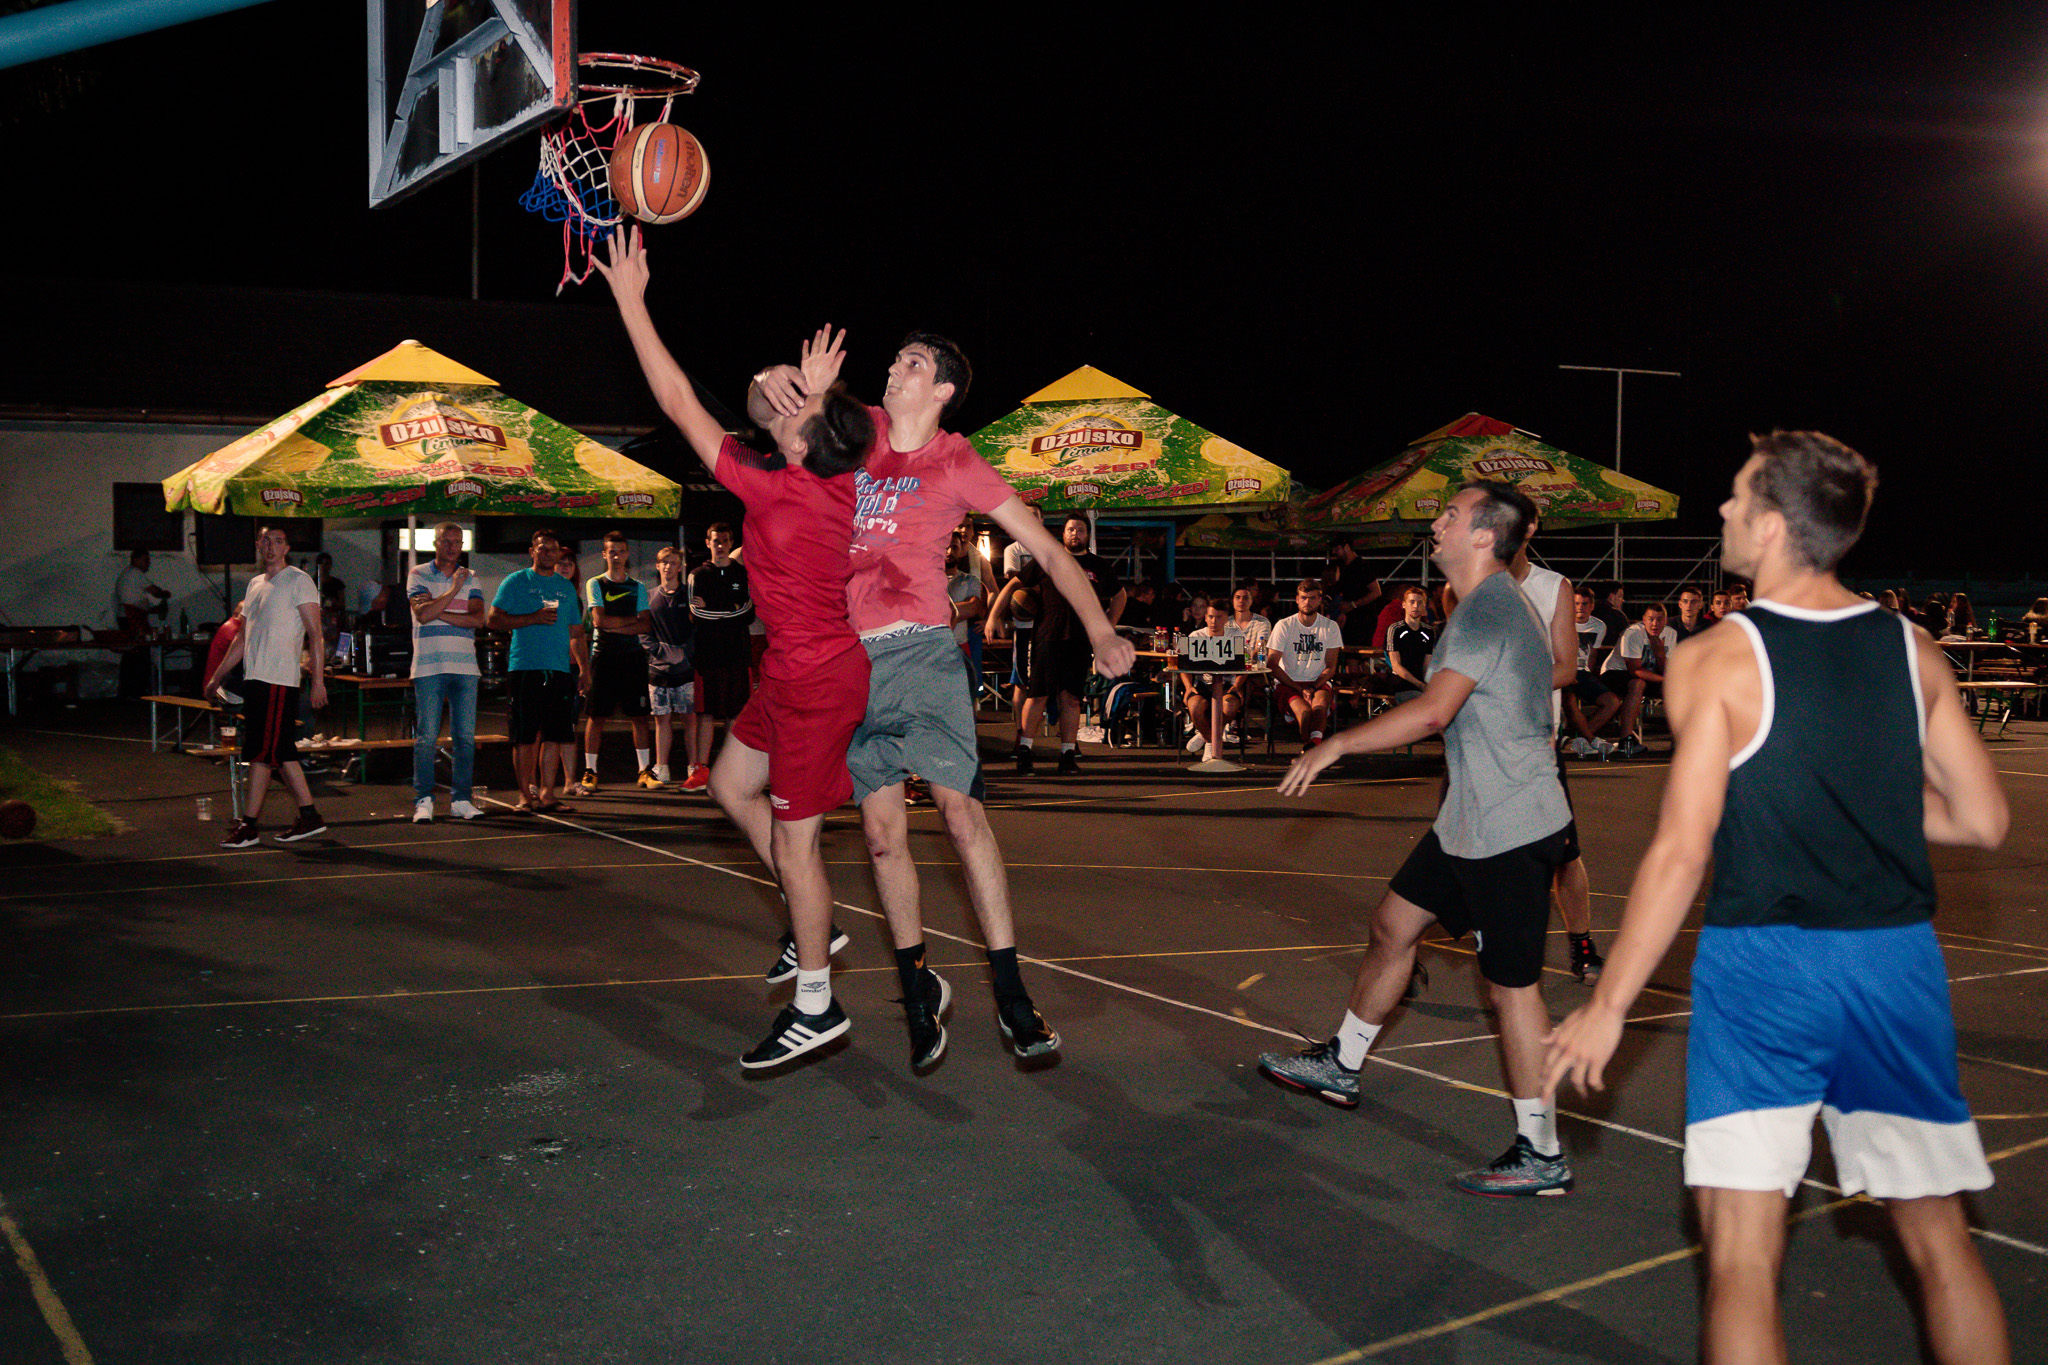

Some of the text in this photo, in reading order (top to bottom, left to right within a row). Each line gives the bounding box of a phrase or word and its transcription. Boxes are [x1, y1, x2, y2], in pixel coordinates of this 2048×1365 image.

[677, 141, 696, 197] molten
[1040, 429, 1135, 451] Ožujsko
[1192, 640, 1232, 658] 14 14
